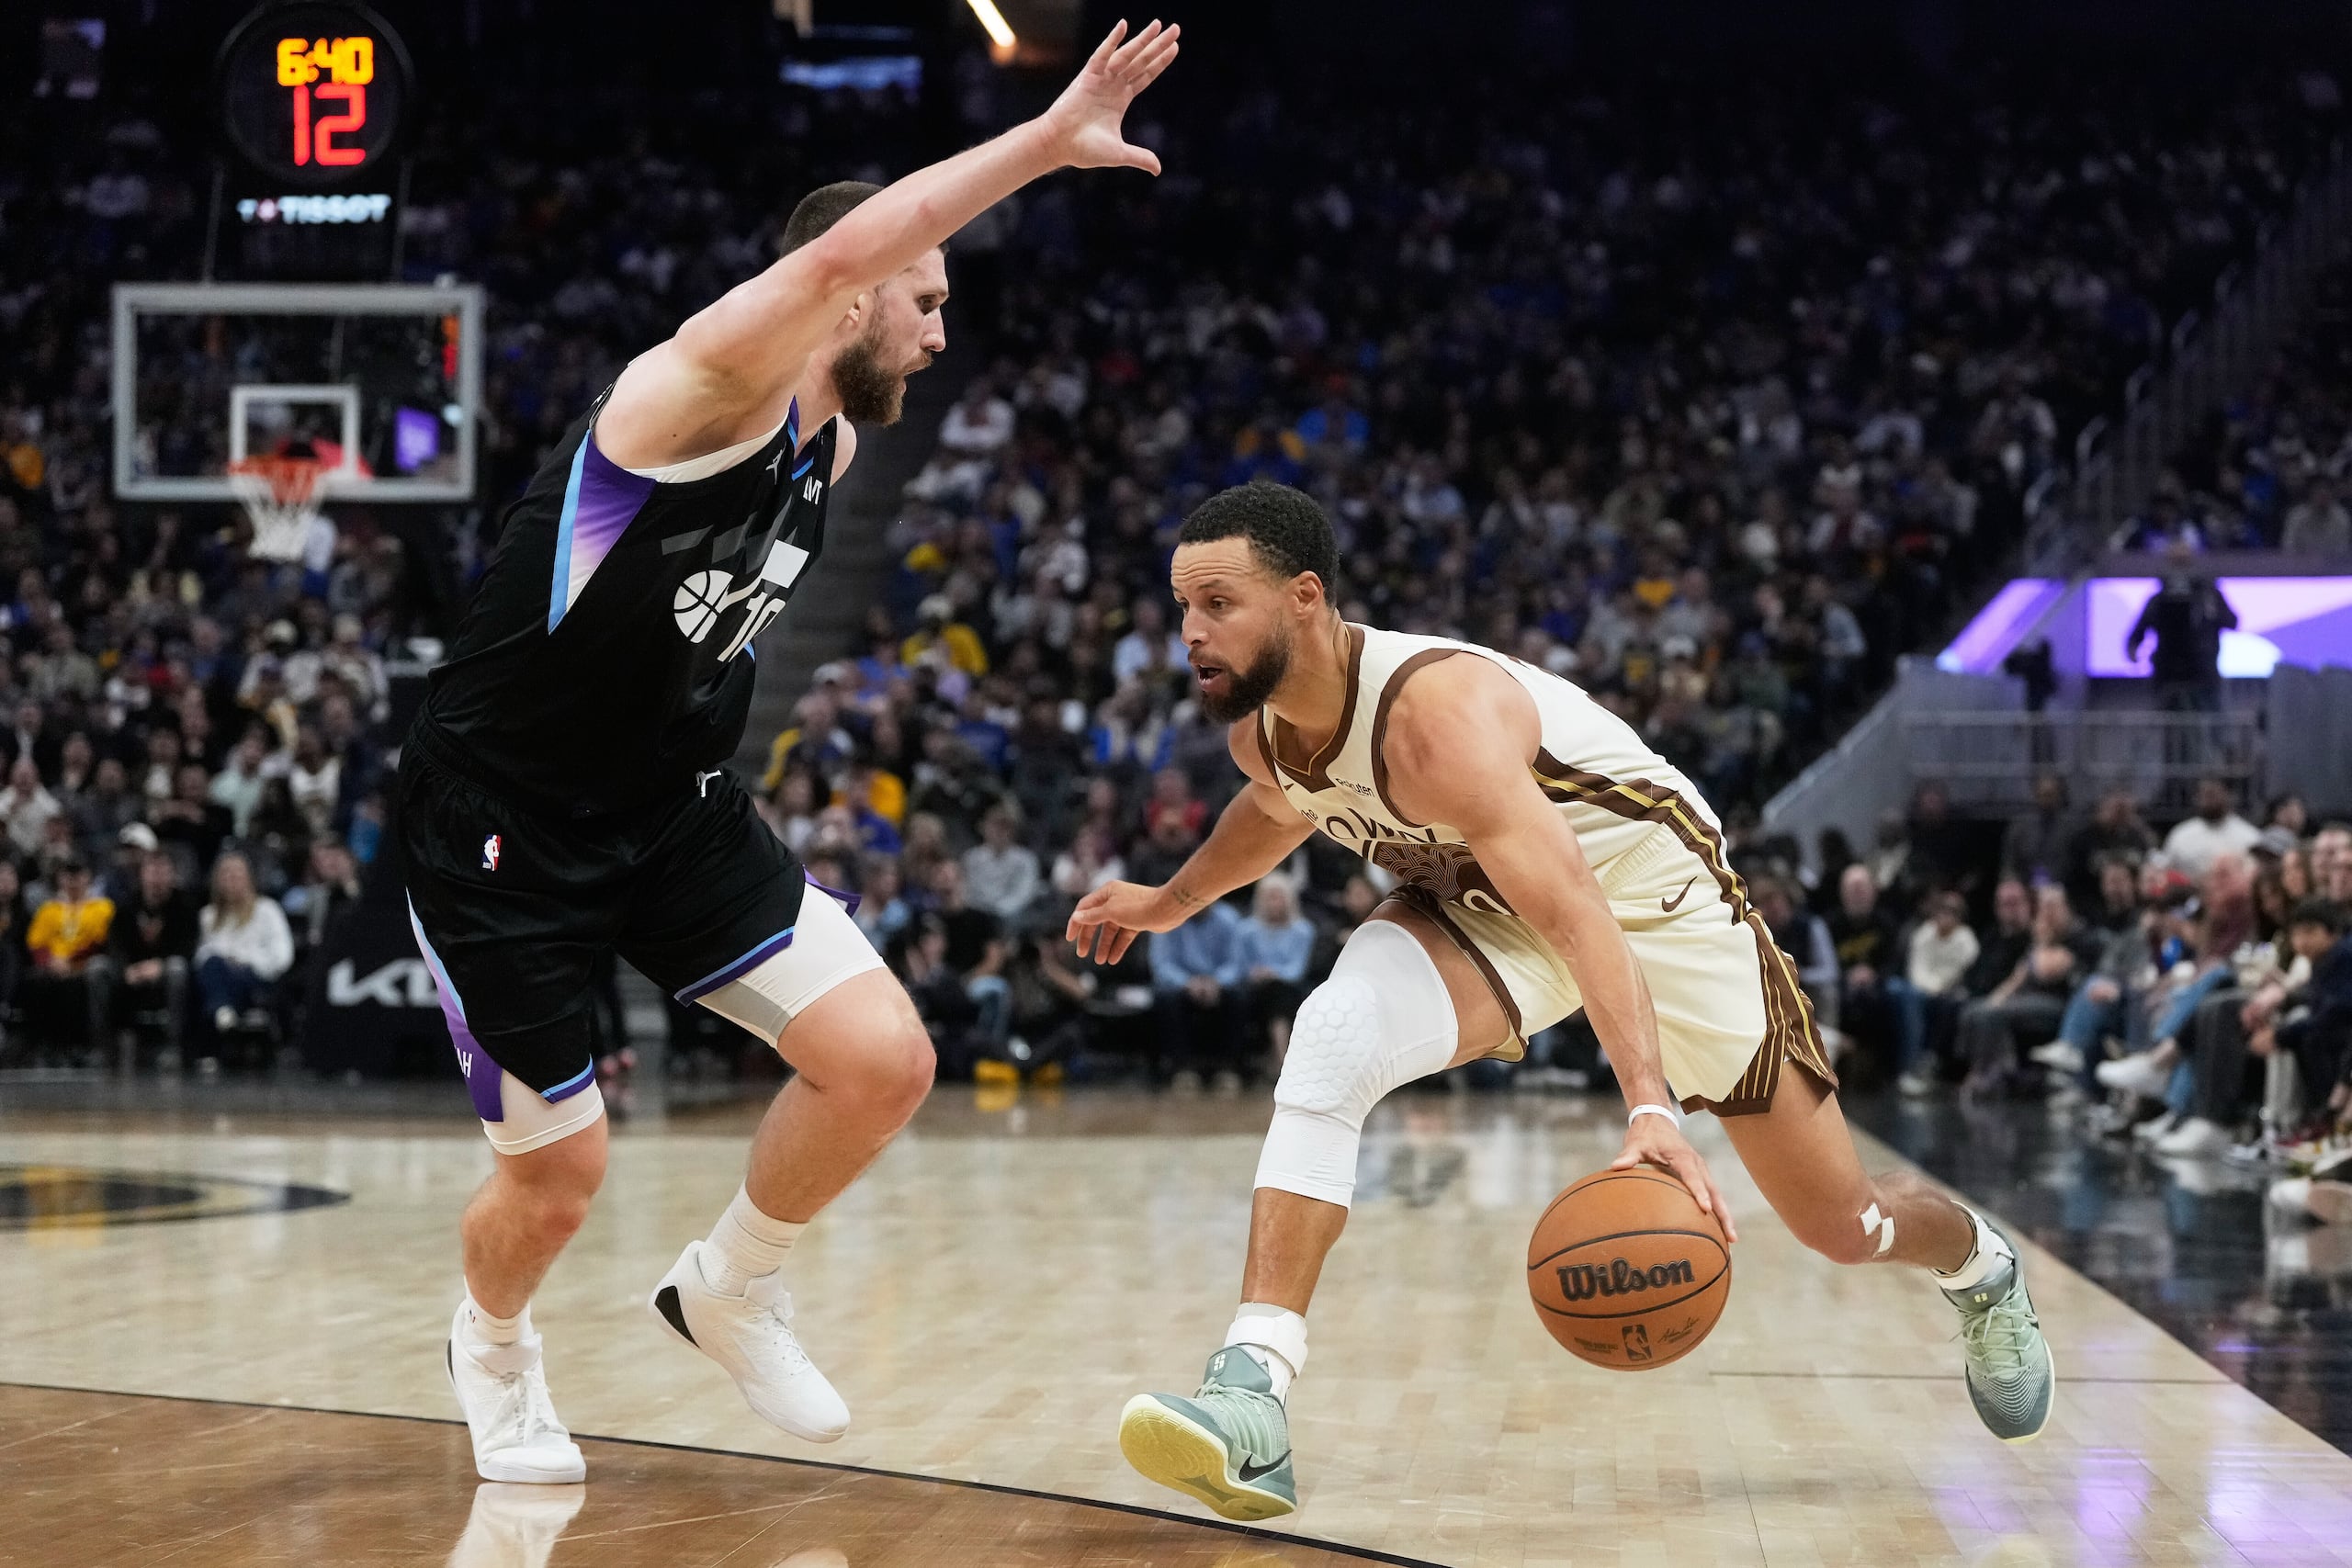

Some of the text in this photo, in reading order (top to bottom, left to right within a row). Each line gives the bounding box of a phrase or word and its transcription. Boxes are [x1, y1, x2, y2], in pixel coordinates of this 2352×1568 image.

[277, 37, 374, 86] 6:40
[293, 83, 366, 166] 12
[277, 194, 391, 224] TISSOT
[717, 591, 786, 663] 10
[1326, 807, 1438, 843] OWN
[1556, 1258, 1696, 1302] Wilson
